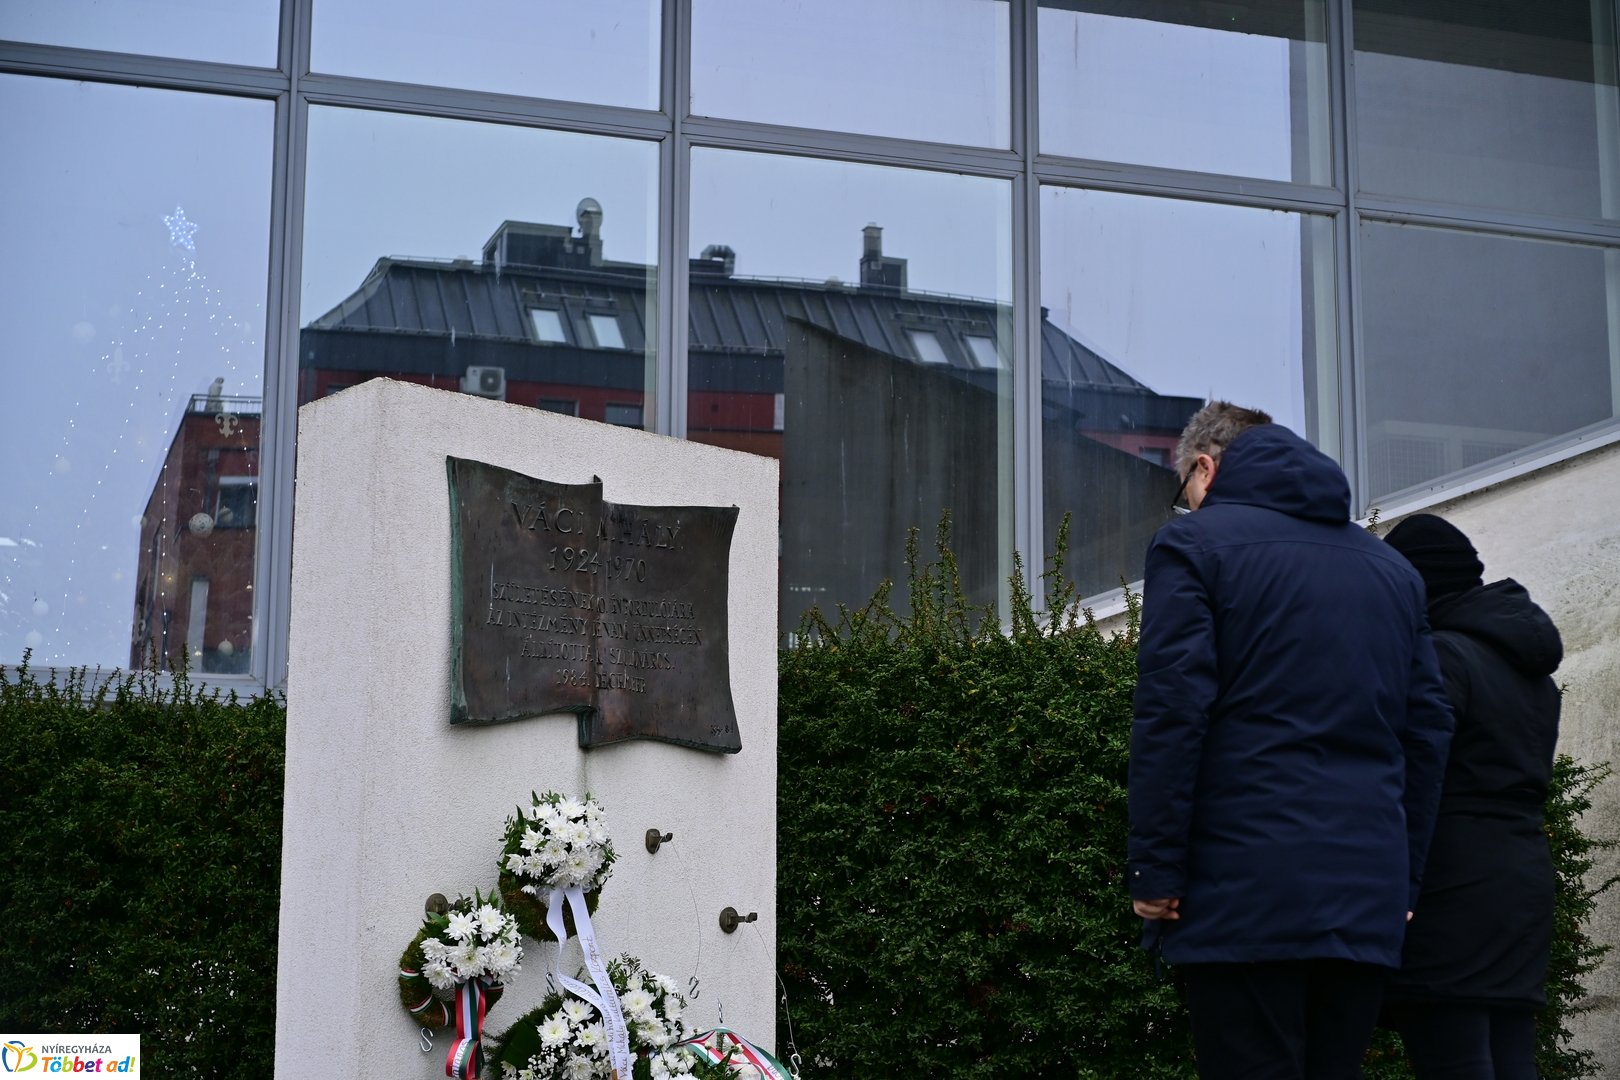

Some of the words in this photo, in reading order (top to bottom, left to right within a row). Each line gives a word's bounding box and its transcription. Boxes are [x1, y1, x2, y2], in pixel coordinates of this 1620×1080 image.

[511, 501, 584, 535] VÁCI
[486, 608, 503, 626] AZ
[506, 610, 588, 636] INTÉZMÉNY
